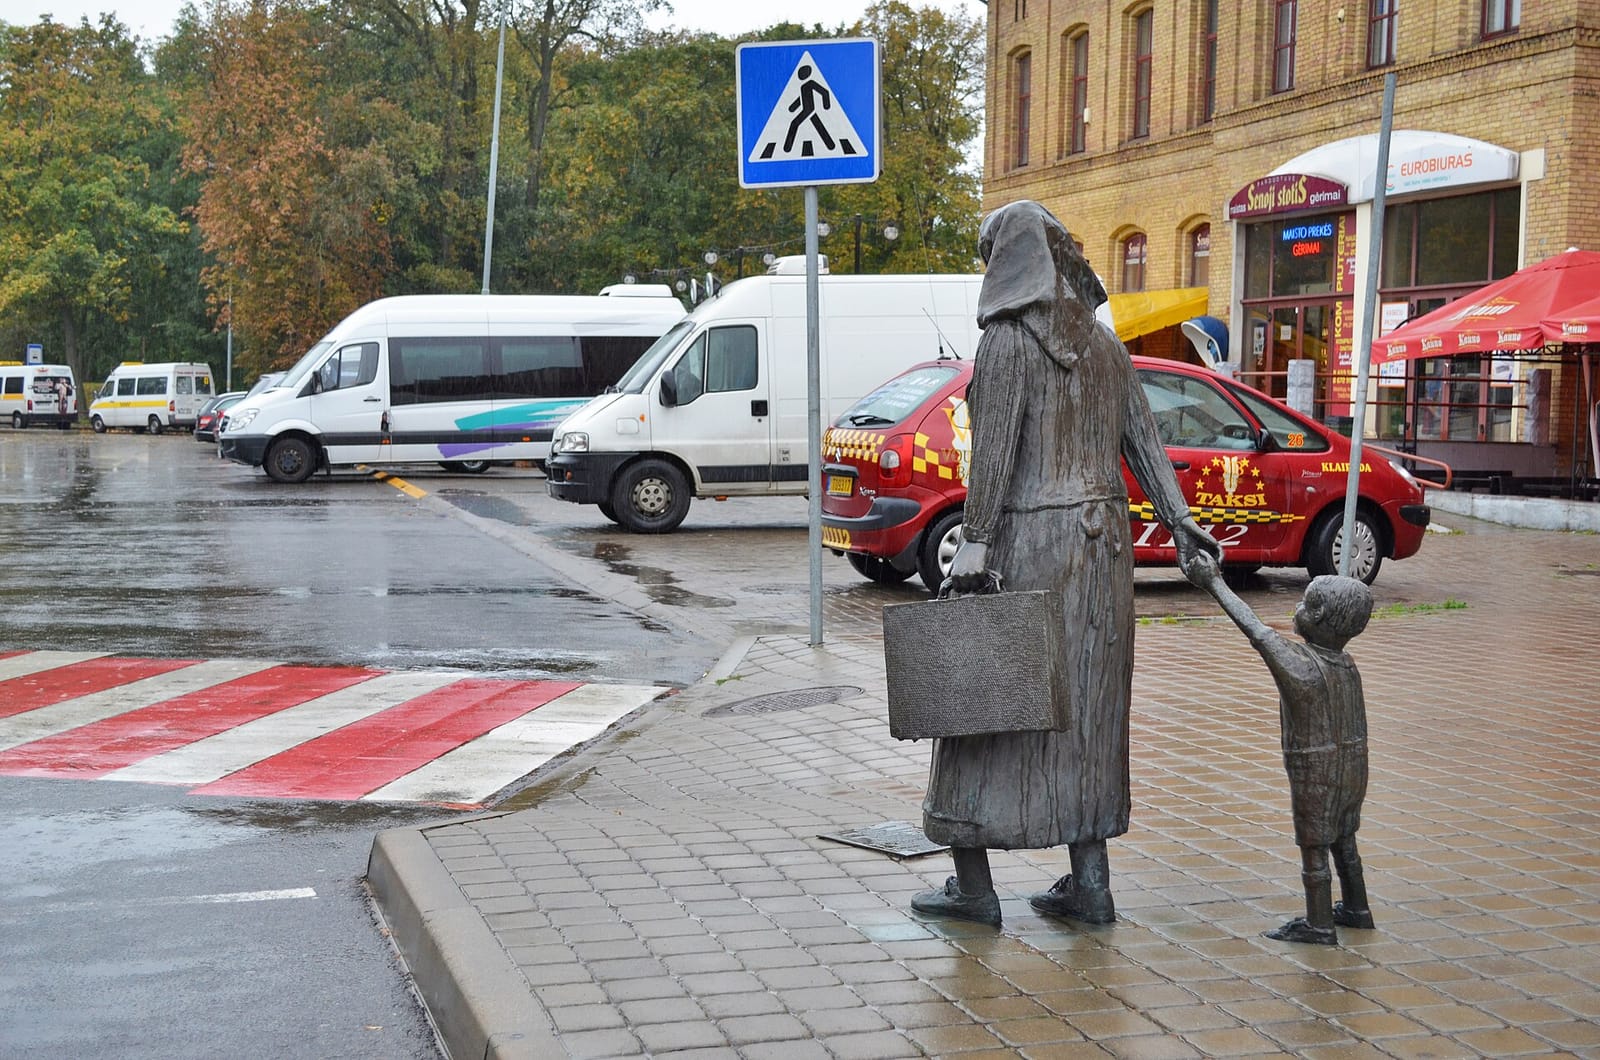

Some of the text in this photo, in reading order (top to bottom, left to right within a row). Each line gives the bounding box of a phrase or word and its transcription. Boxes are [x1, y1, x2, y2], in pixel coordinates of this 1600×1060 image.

[1401, 153, 1473, 177] EUROBIURAS
[1248, 184, 1275, 212] Senoji
[1283, 227, 1307, 240] MAISTO
[1287, 433, 1304, 448] 26
[1321, 462, 1372, 473] KLAIPDA
[1195, 492, 1267, 507] TAKSI
